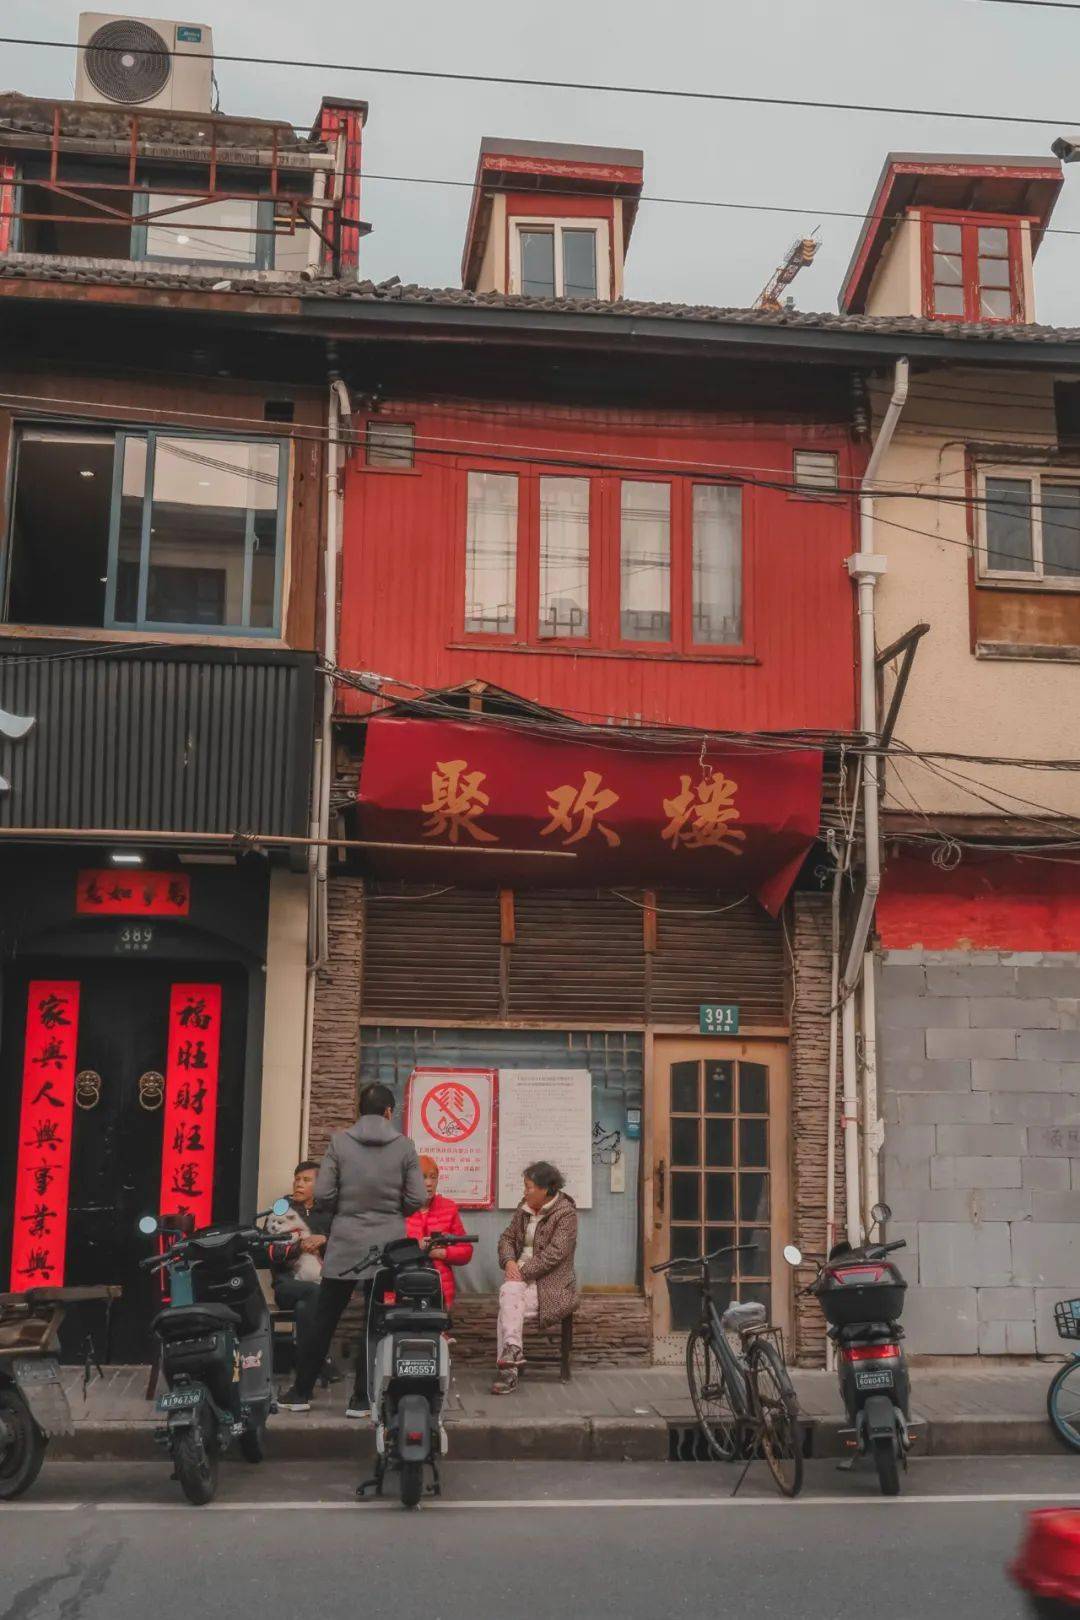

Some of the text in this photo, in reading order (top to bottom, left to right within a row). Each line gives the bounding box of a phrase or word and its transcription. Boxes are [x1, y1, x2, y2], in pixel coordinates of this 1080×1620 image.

[421, 760, 747, 856] 聚欢楼
[121, 928, 153, 942] 389
[705, 1008, 734, 1025] 391
